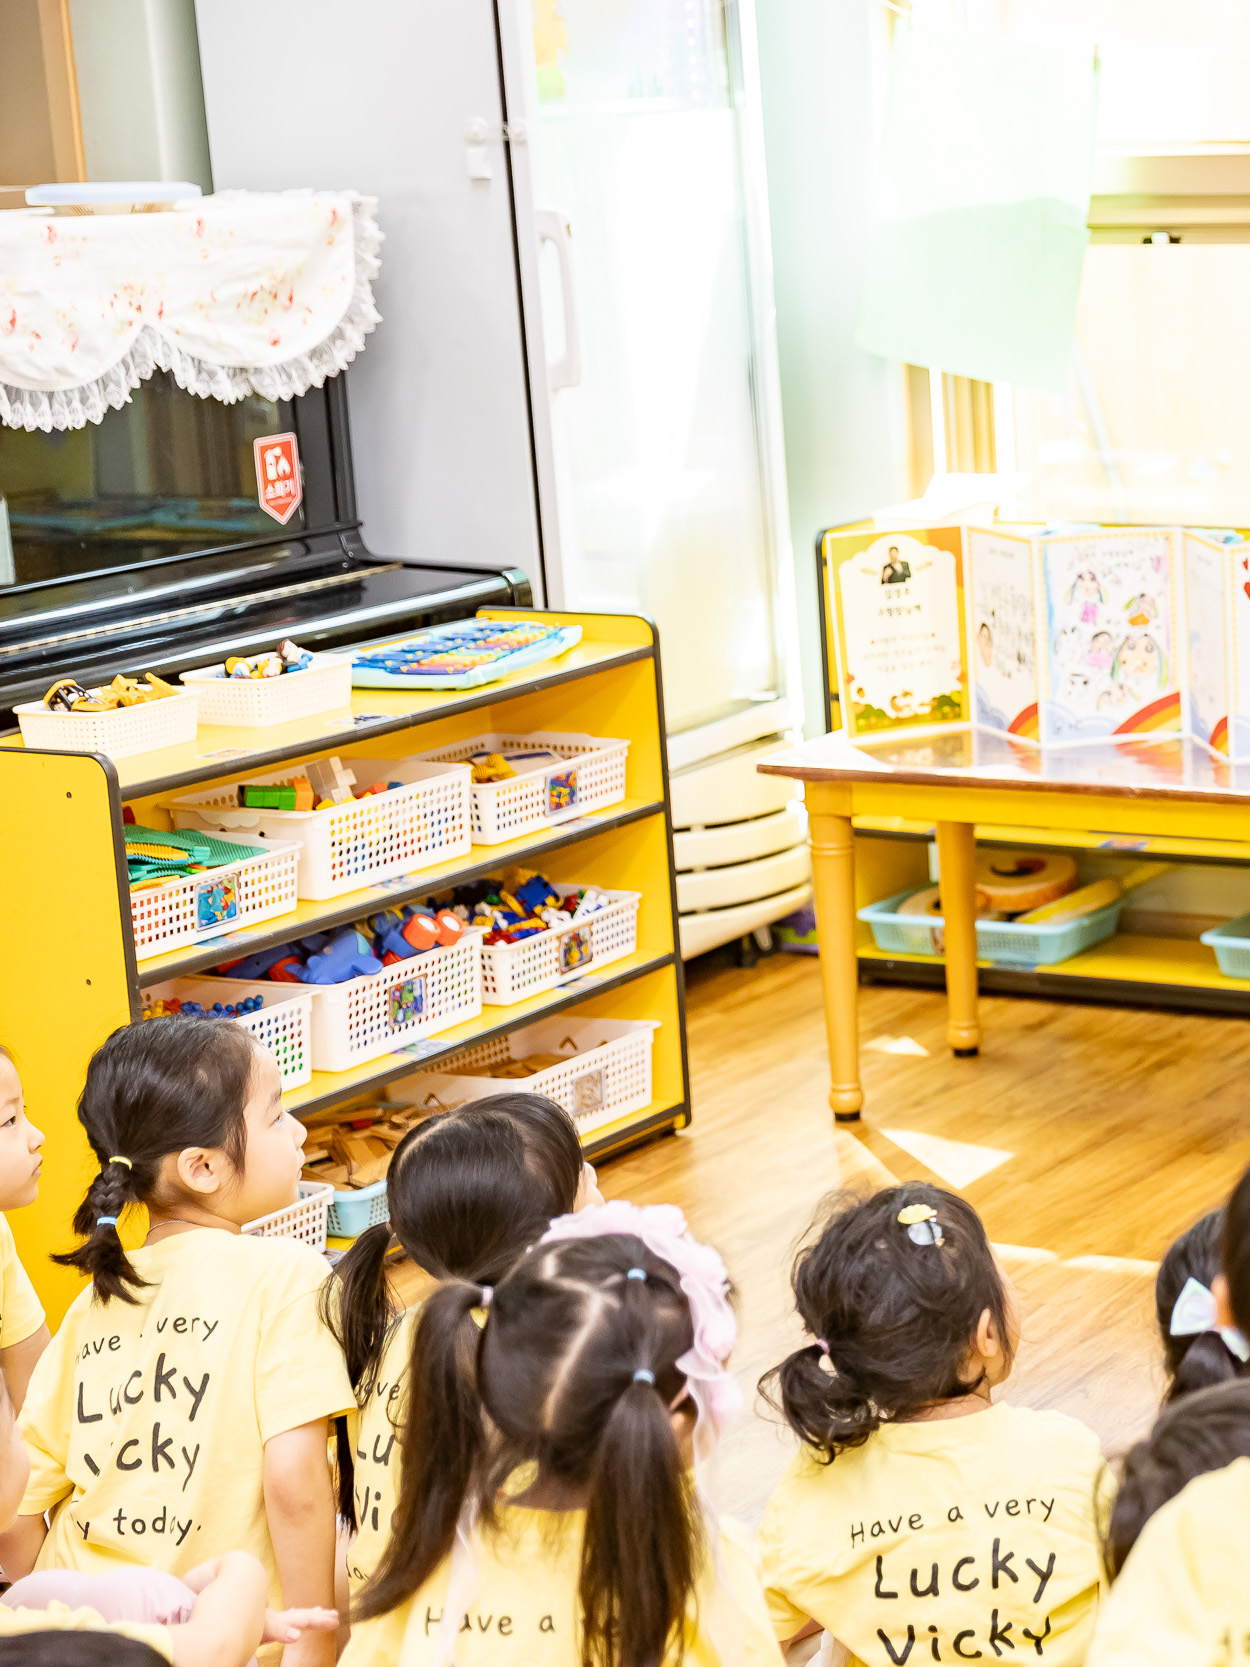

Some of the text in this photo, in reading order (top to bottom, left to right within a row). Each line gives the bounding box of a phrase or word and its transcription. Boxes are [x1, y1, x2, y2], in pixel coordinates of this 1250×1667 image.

[76, 1317, 219, 1365] ave very
[77, 1352, 210, 1422] Lucky
[354, 1379, 400, 1401] ave
[84, 1421, 200, 1492] cky
[851, 1498, 1055, 1548] Have a very
[875, 1537, 1056, 1604] Lucky
[538, 1614, 555, 1634] a
[876, 1608, 1052, 1666] Vicky
